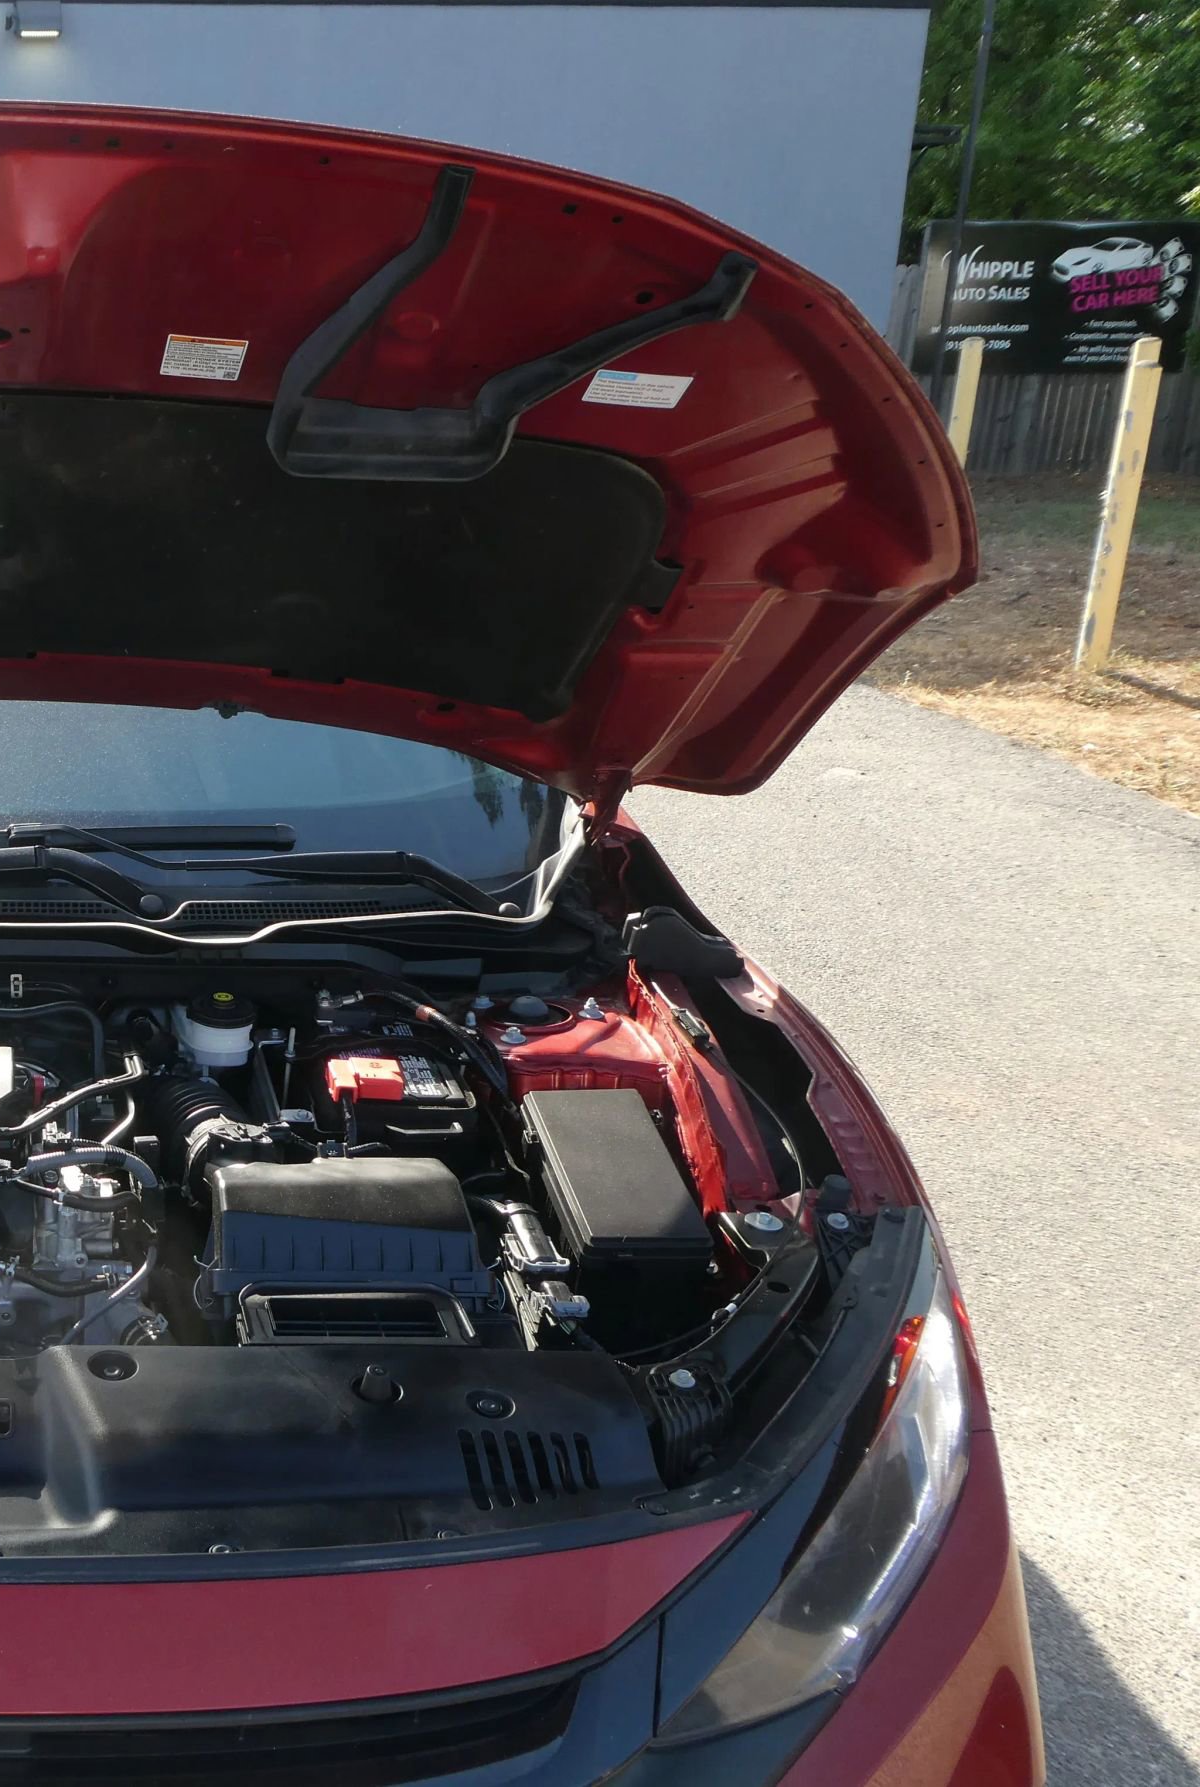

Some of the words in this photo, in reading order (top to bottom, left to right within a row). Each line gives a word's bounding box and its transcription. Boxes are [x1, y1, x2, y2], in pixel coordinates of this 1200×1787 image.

[1071, 273, 1111, 293] SELL
[1114, 264, 1164, 286] YOUR
[987, 285, 1031, 301] SALES
[1072, 291, 1110, 312] CAR
[1113, 284, 1160, 306] HERE
